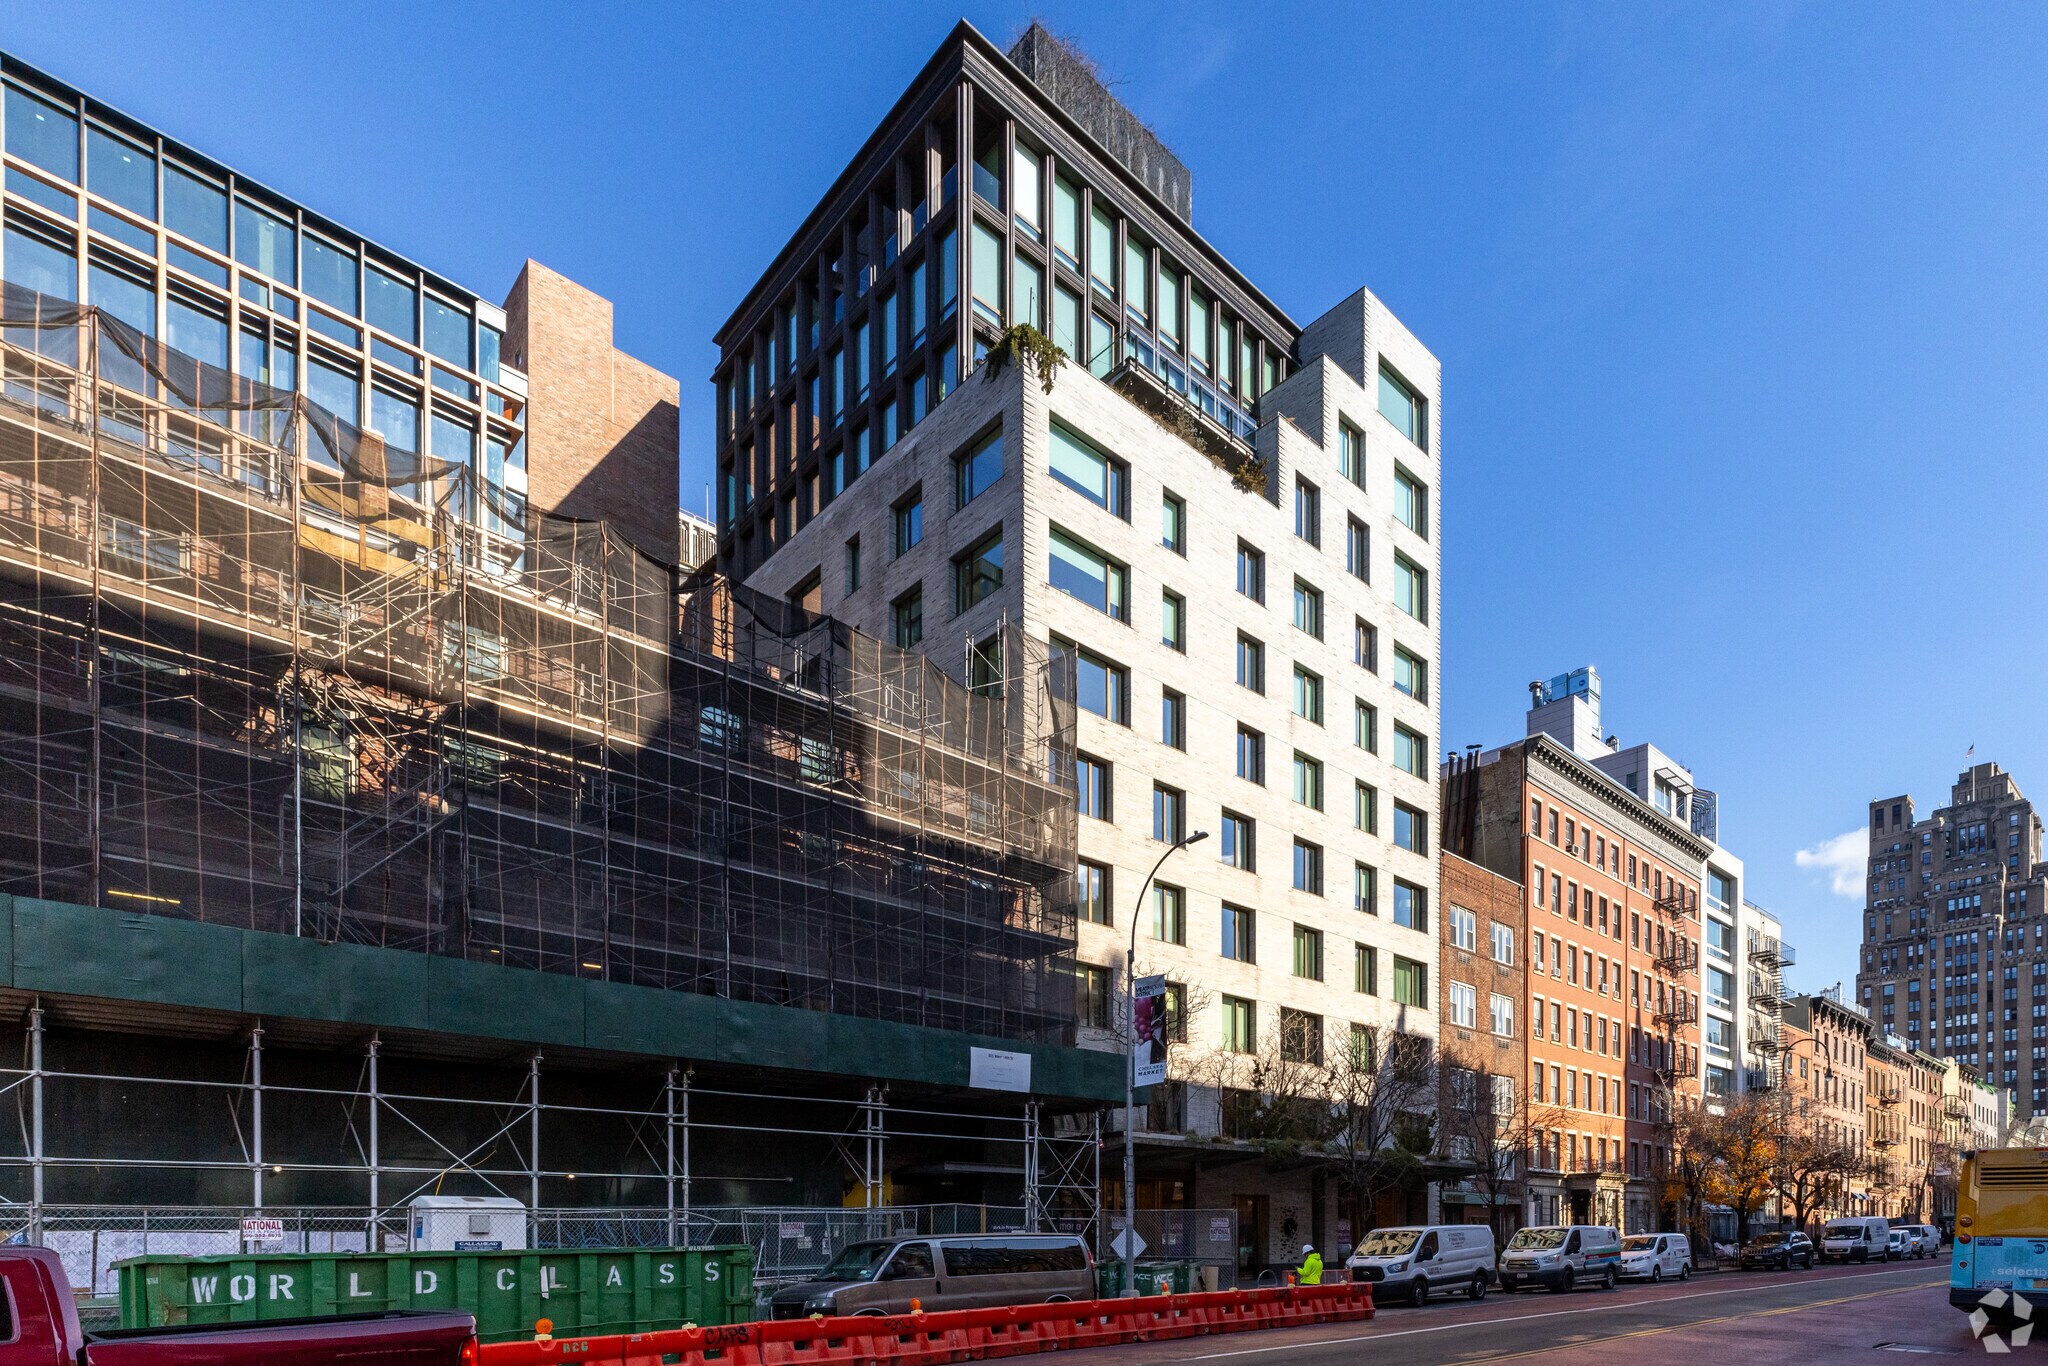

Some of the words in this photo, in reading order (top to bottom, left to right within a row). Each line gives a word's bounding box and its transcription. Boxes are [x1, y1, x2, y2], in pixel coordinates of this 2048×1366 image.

[243, 1221, 281, 1230] NATIONAL
[191, 1270, 438, 1303] WORLD
[496, 1261, 720, 1291] CLASS
